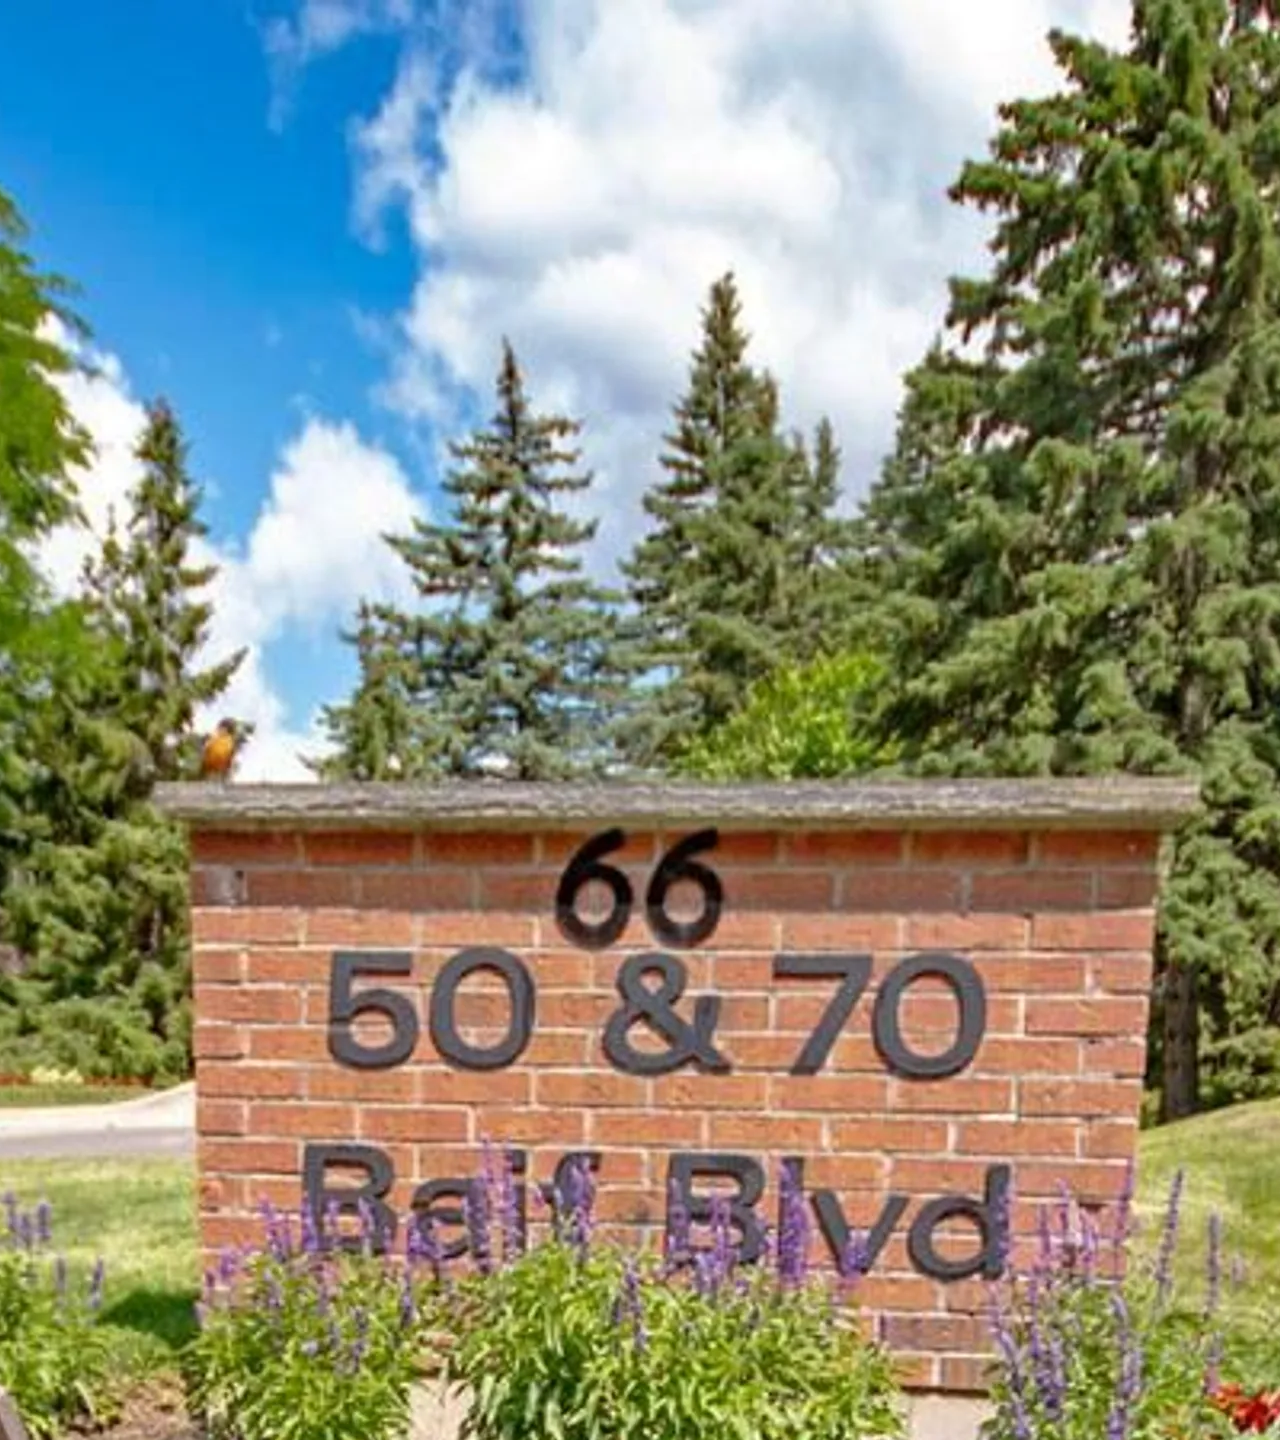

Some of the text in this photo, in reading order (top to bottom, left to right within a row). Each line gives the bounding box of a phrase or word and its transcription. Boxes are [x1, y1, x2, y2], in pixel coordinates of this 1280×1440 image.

[555, 828, 724, 949] 66
[326, 946, 987, 1081] 50 & 70
